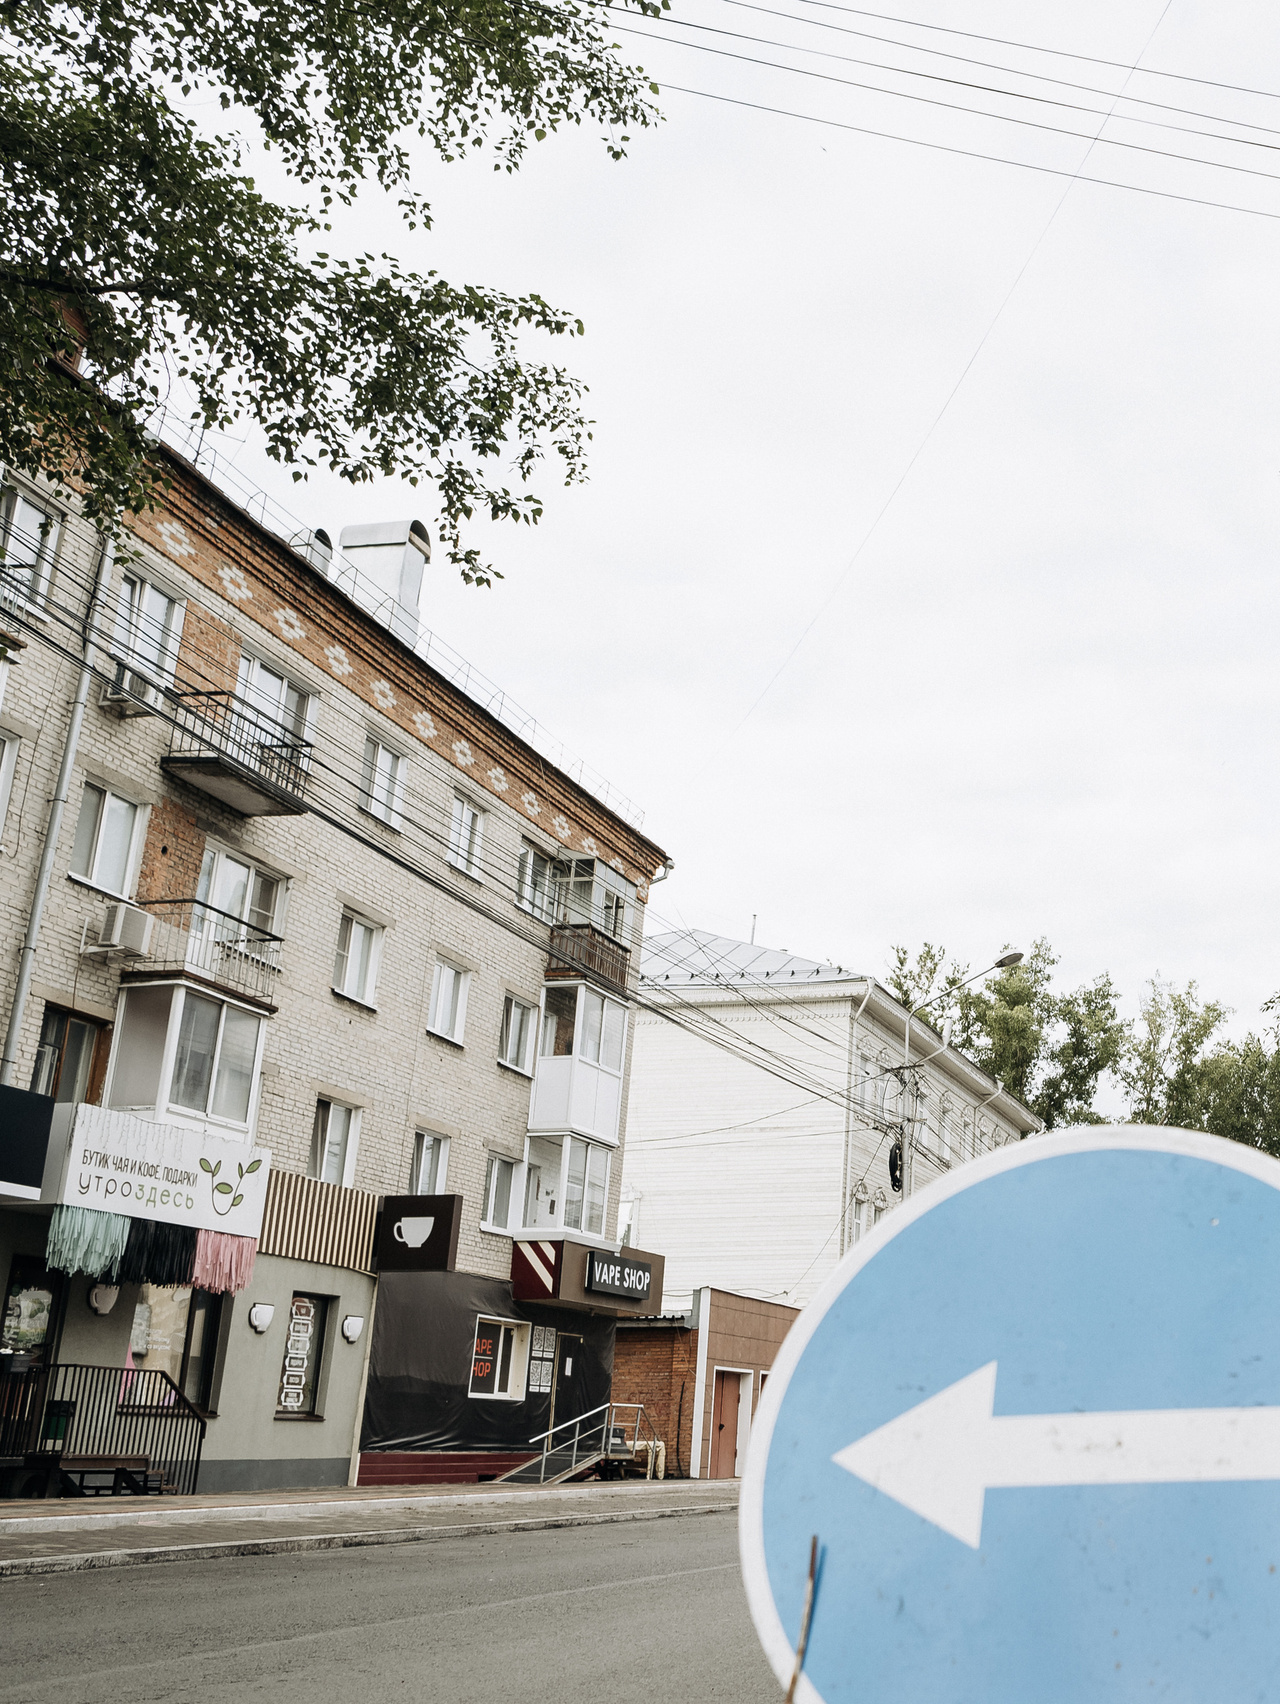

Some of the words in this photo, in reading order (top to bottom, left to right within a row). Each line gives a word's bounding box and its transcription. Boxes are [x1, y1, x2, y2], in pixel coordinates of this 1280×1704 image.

[82, 1149, 111, 1169] БУТИК
[112, 1155, 130, 1173] ЧАЯ
[130, 1159, 137, 1174] И
[138, 1161, 161, 1180] КОФЕ,
[162, 1166, 198, 1188] ПОДАРКИ
[595, 1261, 621, 1286] VAPE
[623, 1267, 650, 1291] SHOP
[475, 1338, 492, 1354] APE
[473, 1361, 491, 1377] HOP
